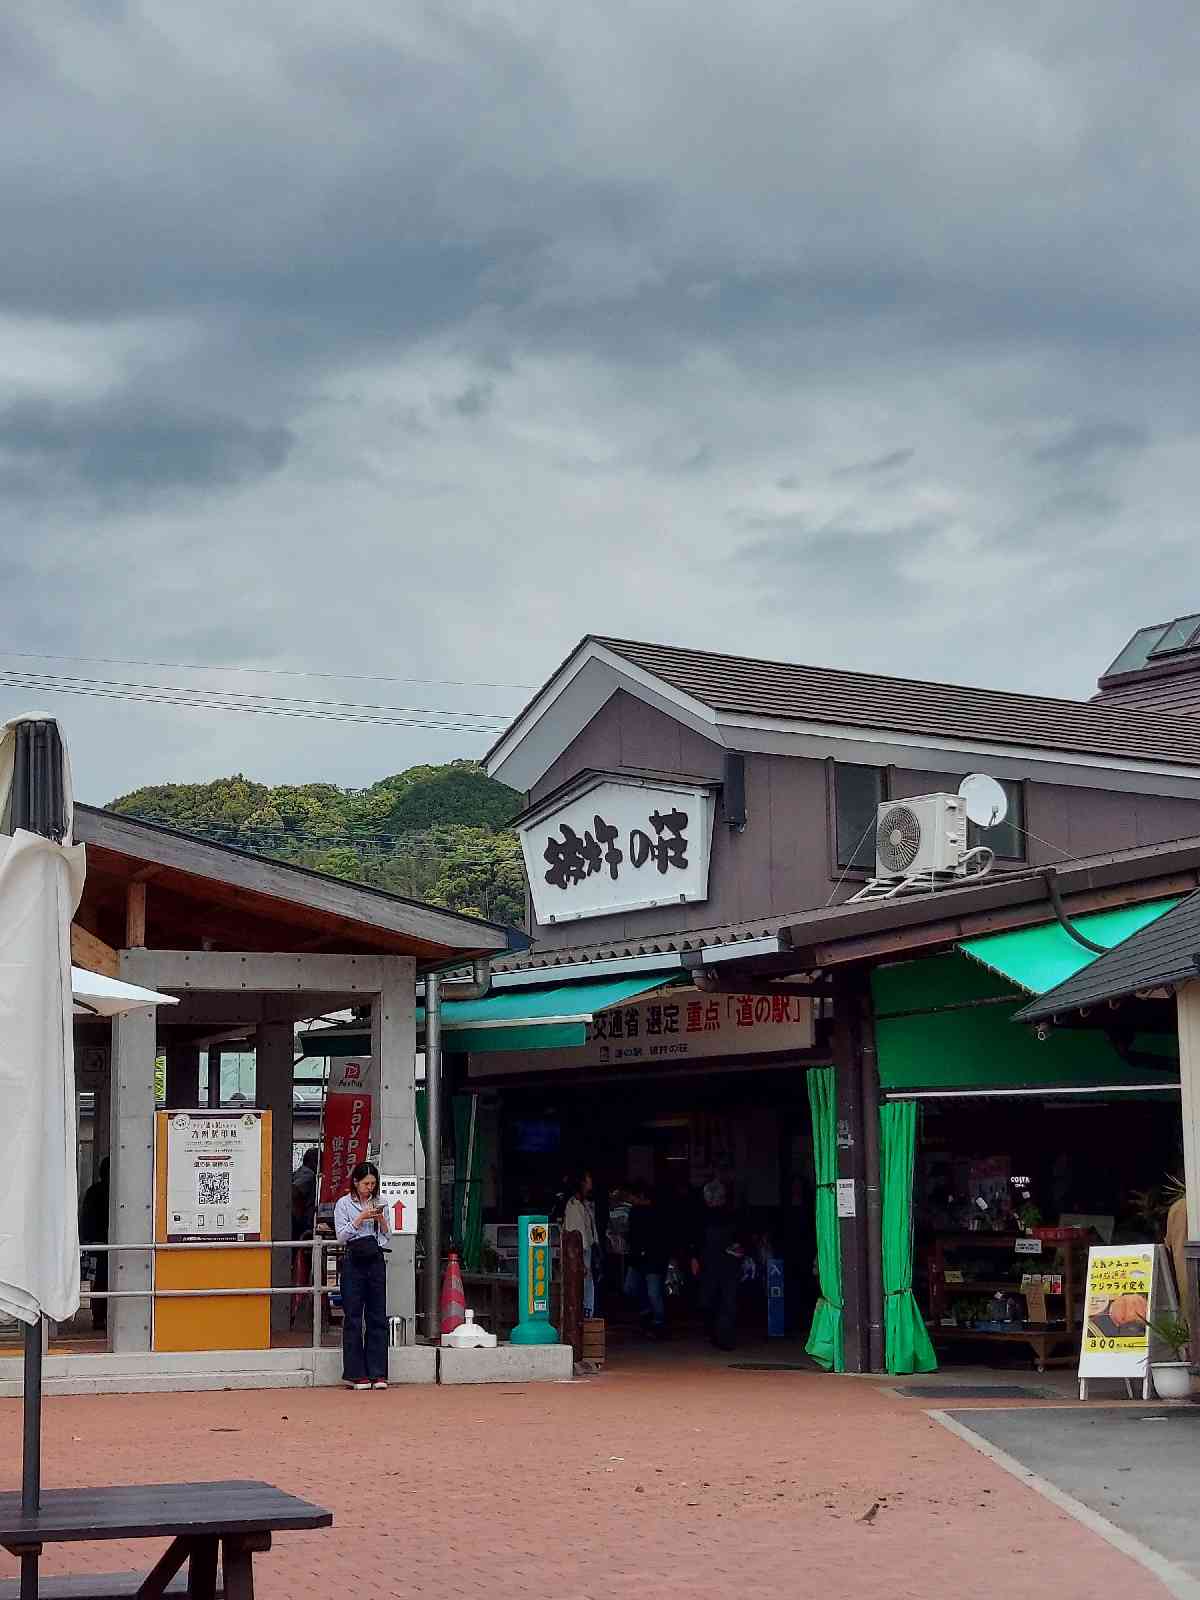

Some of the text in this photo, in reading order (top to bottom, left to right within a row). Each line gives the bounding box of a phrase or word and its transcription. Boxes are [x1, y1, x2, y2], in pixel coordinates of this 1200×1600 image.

[646, 1003, 680, 1035] 選定
[686, 1001, 721, 1033] 重点
[1010, 1176, 1031, 1184] COSTA
